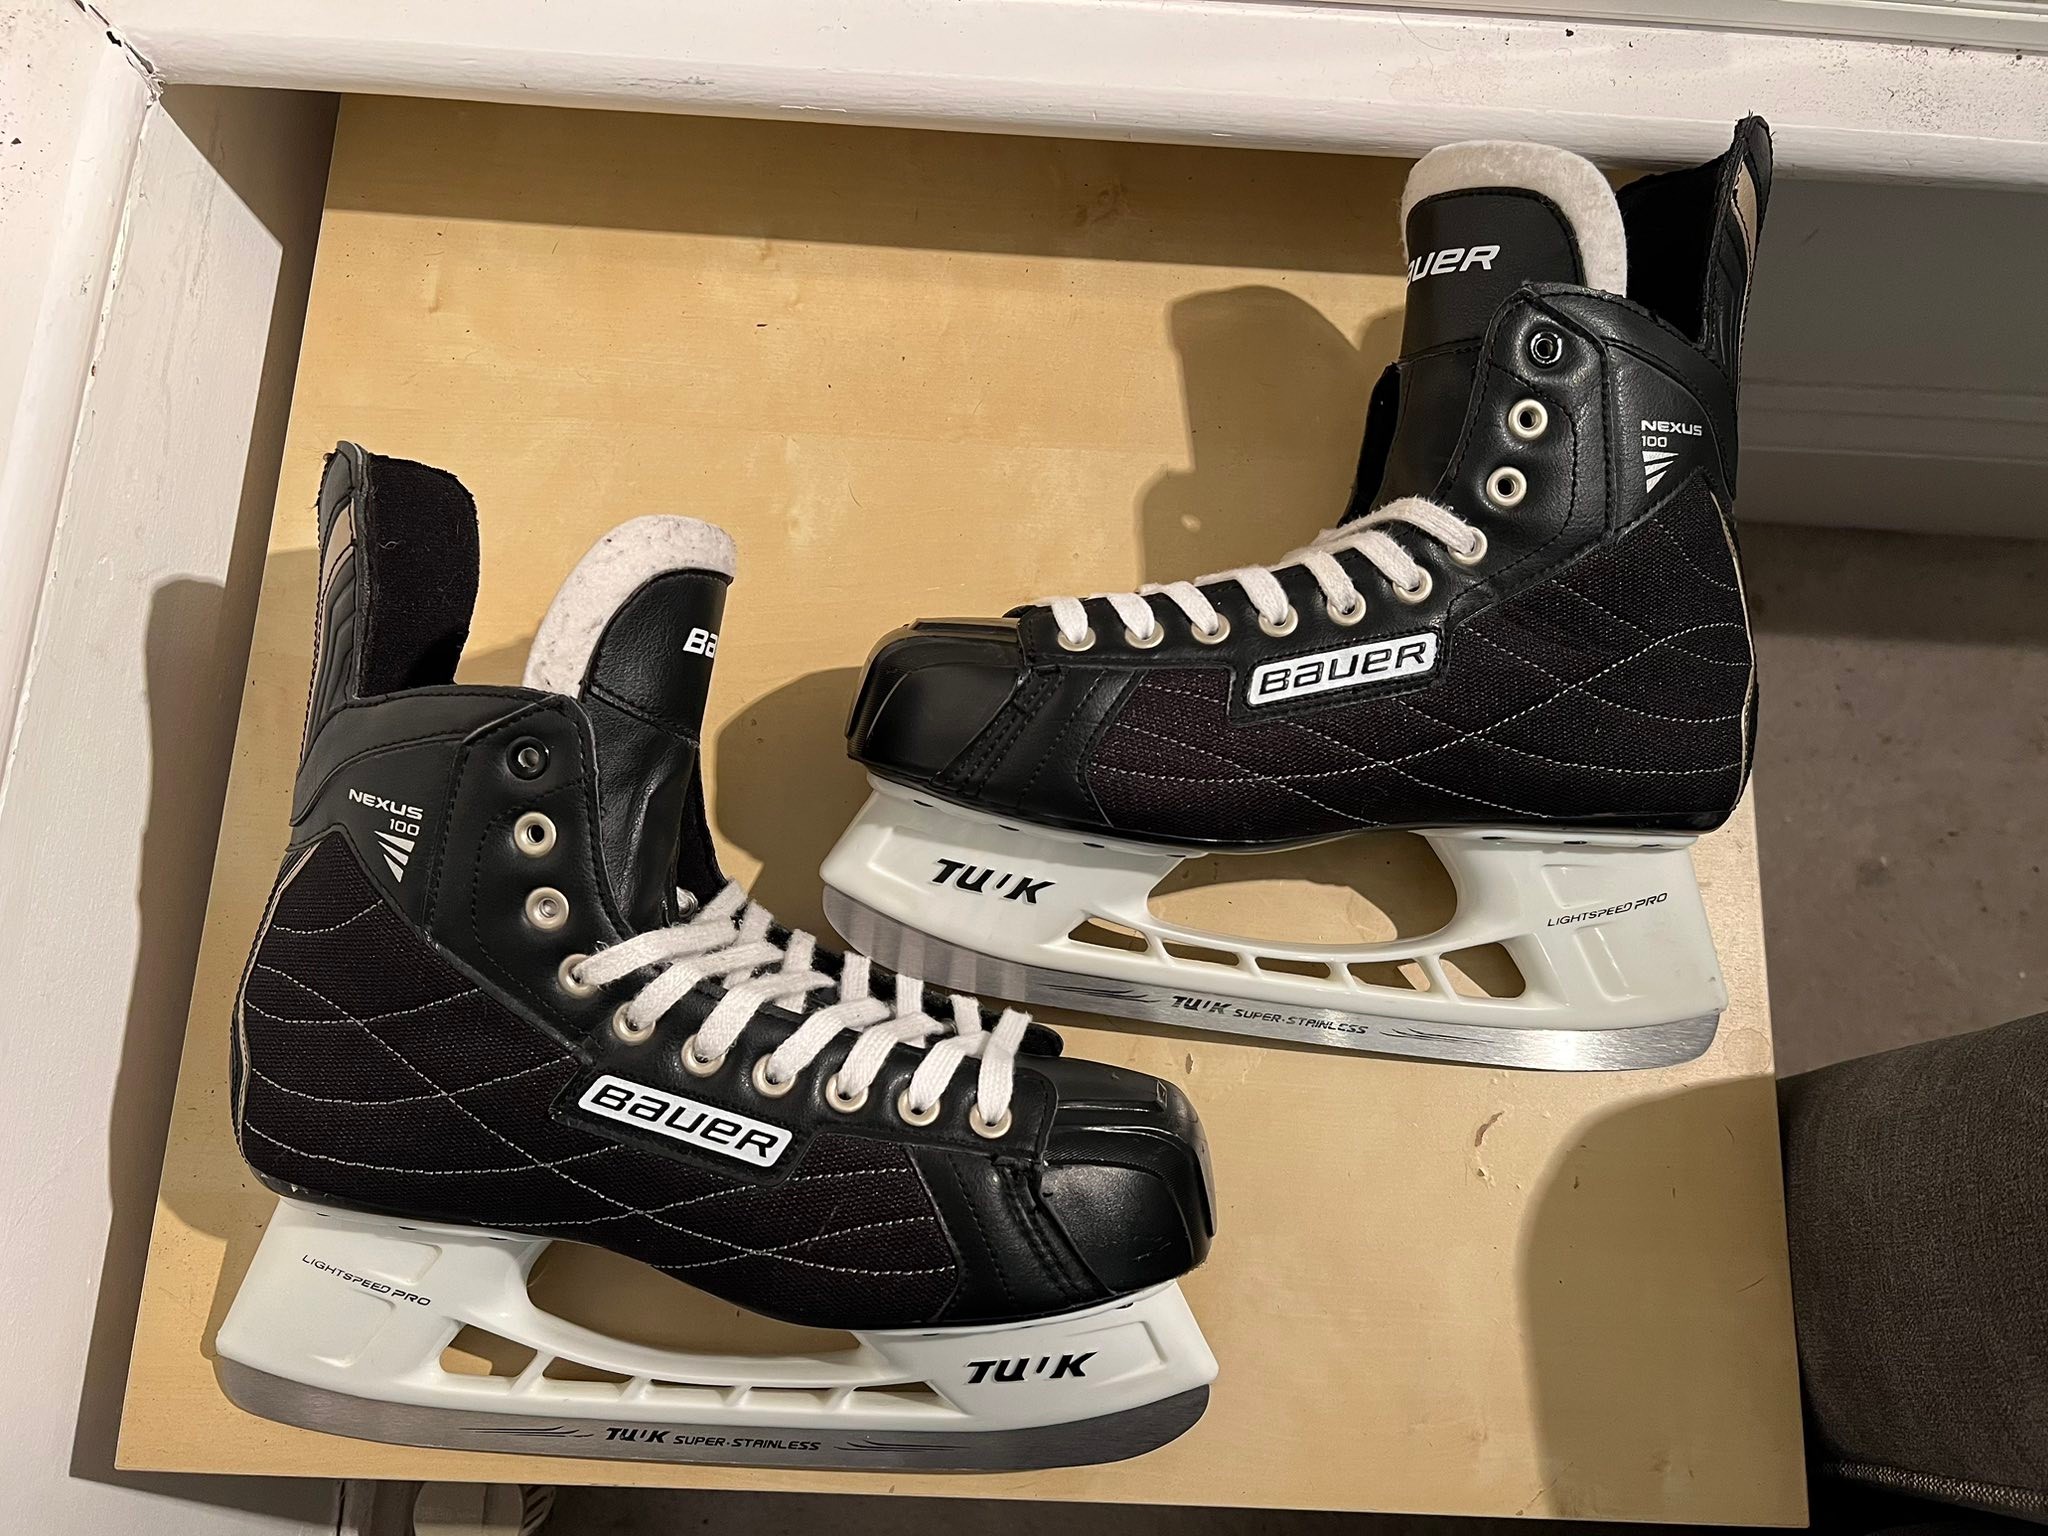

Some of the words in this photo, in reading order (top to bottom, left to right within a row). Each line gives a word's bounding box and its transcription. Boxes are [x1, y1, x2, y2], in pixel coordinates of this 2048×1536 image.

[1641, 420, 1702, 436] NEXUS
[1642, 436, 1667, 447] 100
[348, 788, 424, 820] NEXUS
[389, 818, 420, 836] 100
[1547, 901, 1633, 927] LIGHTSPEED
[1634, 892, 1668, 910] PRO
[302, 1254, 391, 1293] LIGHTSPEED
[391, 1289, 431, 1306] PRO
